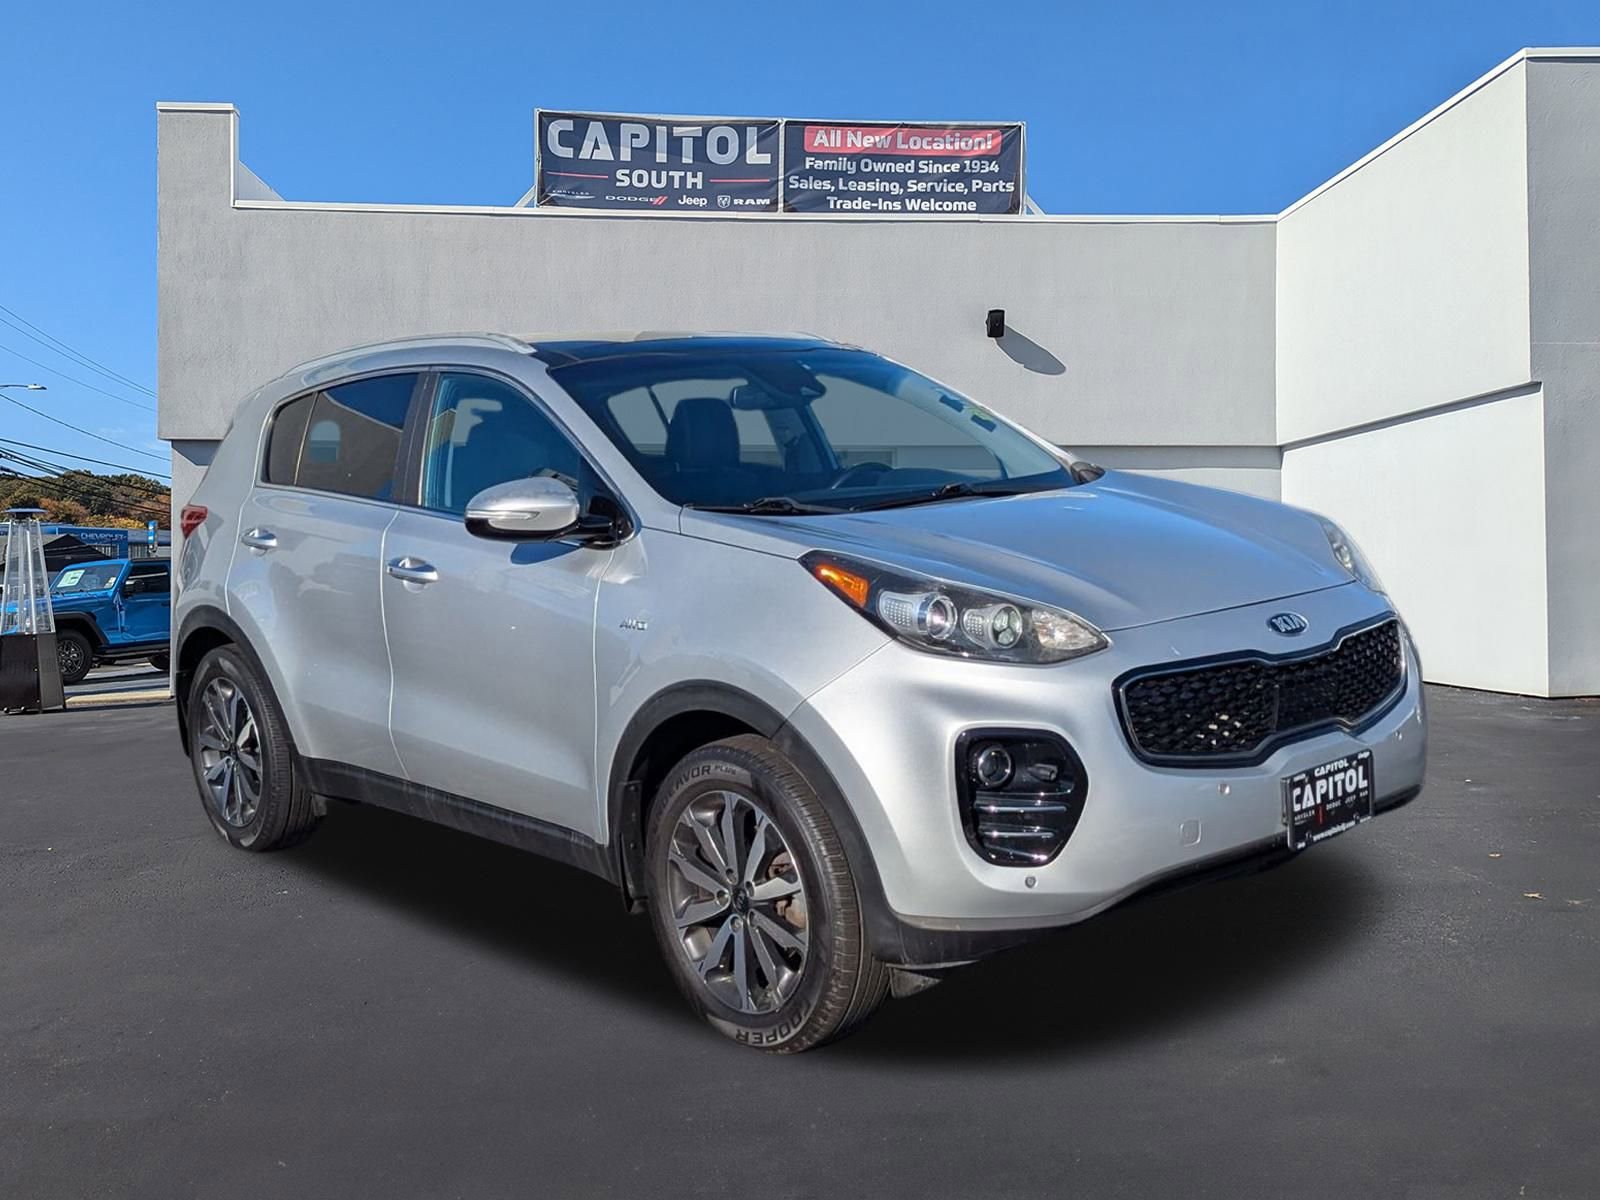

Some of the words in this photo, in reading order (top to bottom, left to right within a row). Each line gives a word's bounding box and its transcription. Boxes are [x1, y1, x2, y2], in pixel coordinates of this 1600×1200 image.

[547, 119, 771, 165] CAPITOL
[813, 129, 841, 148] All
[847, 131, 893, 149] New
[896, 132, 993, 150] Location!
[805, 157, 857, 174] Family
[860, 158, 915, 173] Owned
[918, 159, 960, 173] Since
[963, 160, 1000, 173] 1934
[615, 168, 703, 190] SOUTH
[788, 176, 835, 191] Sales,
[838, 177, 904, 195] Leasing,
[907, 179, 968, 195] Service,
[971, 180, 1015, 193] Parts
[678, 194, 707, 207] Jeep
[733, 198, 770, 206] RAM
[826, 196, 901, 211] Trade-Ins
[905, 198, 977, 212] Welcome
[1272, 614, 1305, 632] KIA
[1314, 758, 1349, 777] CAPITOL
[1293, 765, 1368, 812] CAPITOL
